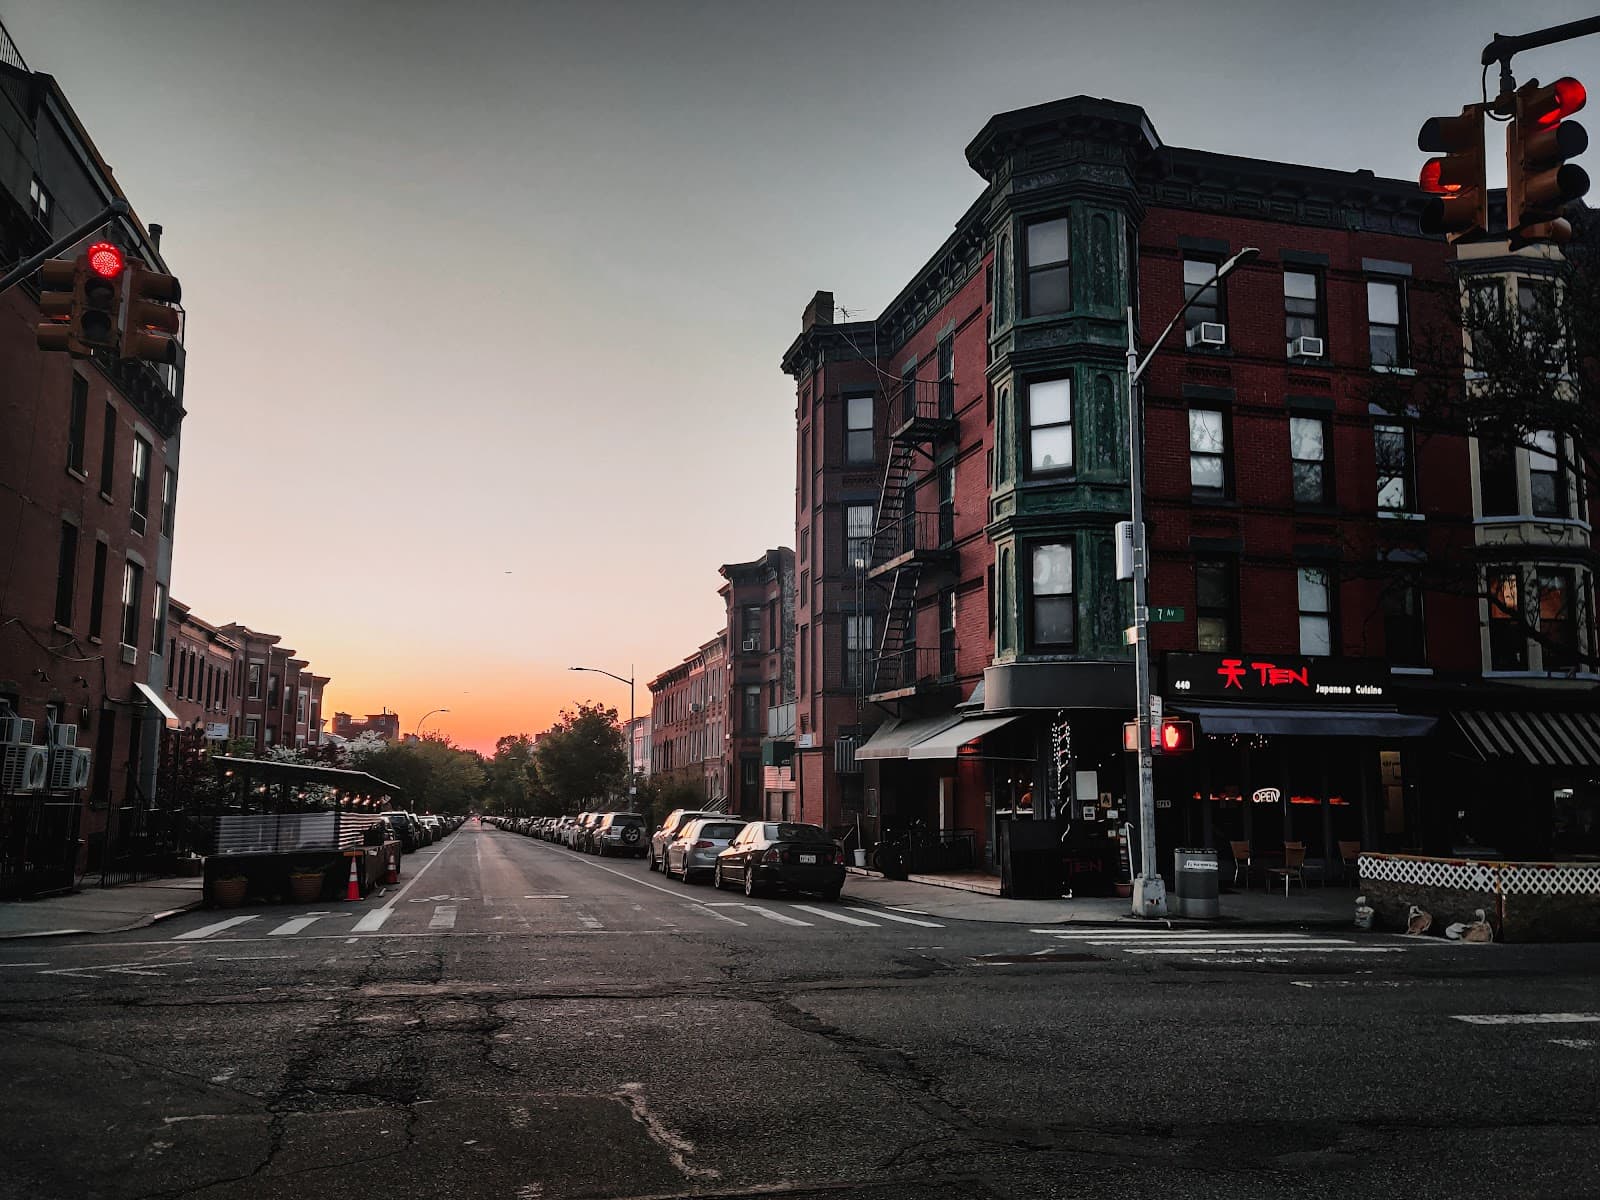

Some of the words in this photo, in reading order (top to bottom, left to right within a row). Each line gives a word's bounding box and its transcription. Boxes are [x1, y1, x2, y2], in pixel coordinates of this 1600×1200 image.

[1157, 608, 1163, 621] 7
[1166, 608, 1175, 617] AV
[1216, 658, 1247, 690] 天
[1250, 661, 1310, 688] TEN
[1175, 680, 1191, 690] 440
[1315, 683, 1351, 697] Japanese
[1355, 684, 1383, 697] Cuisine
[1252, 790, 1279, 803] OPEN
